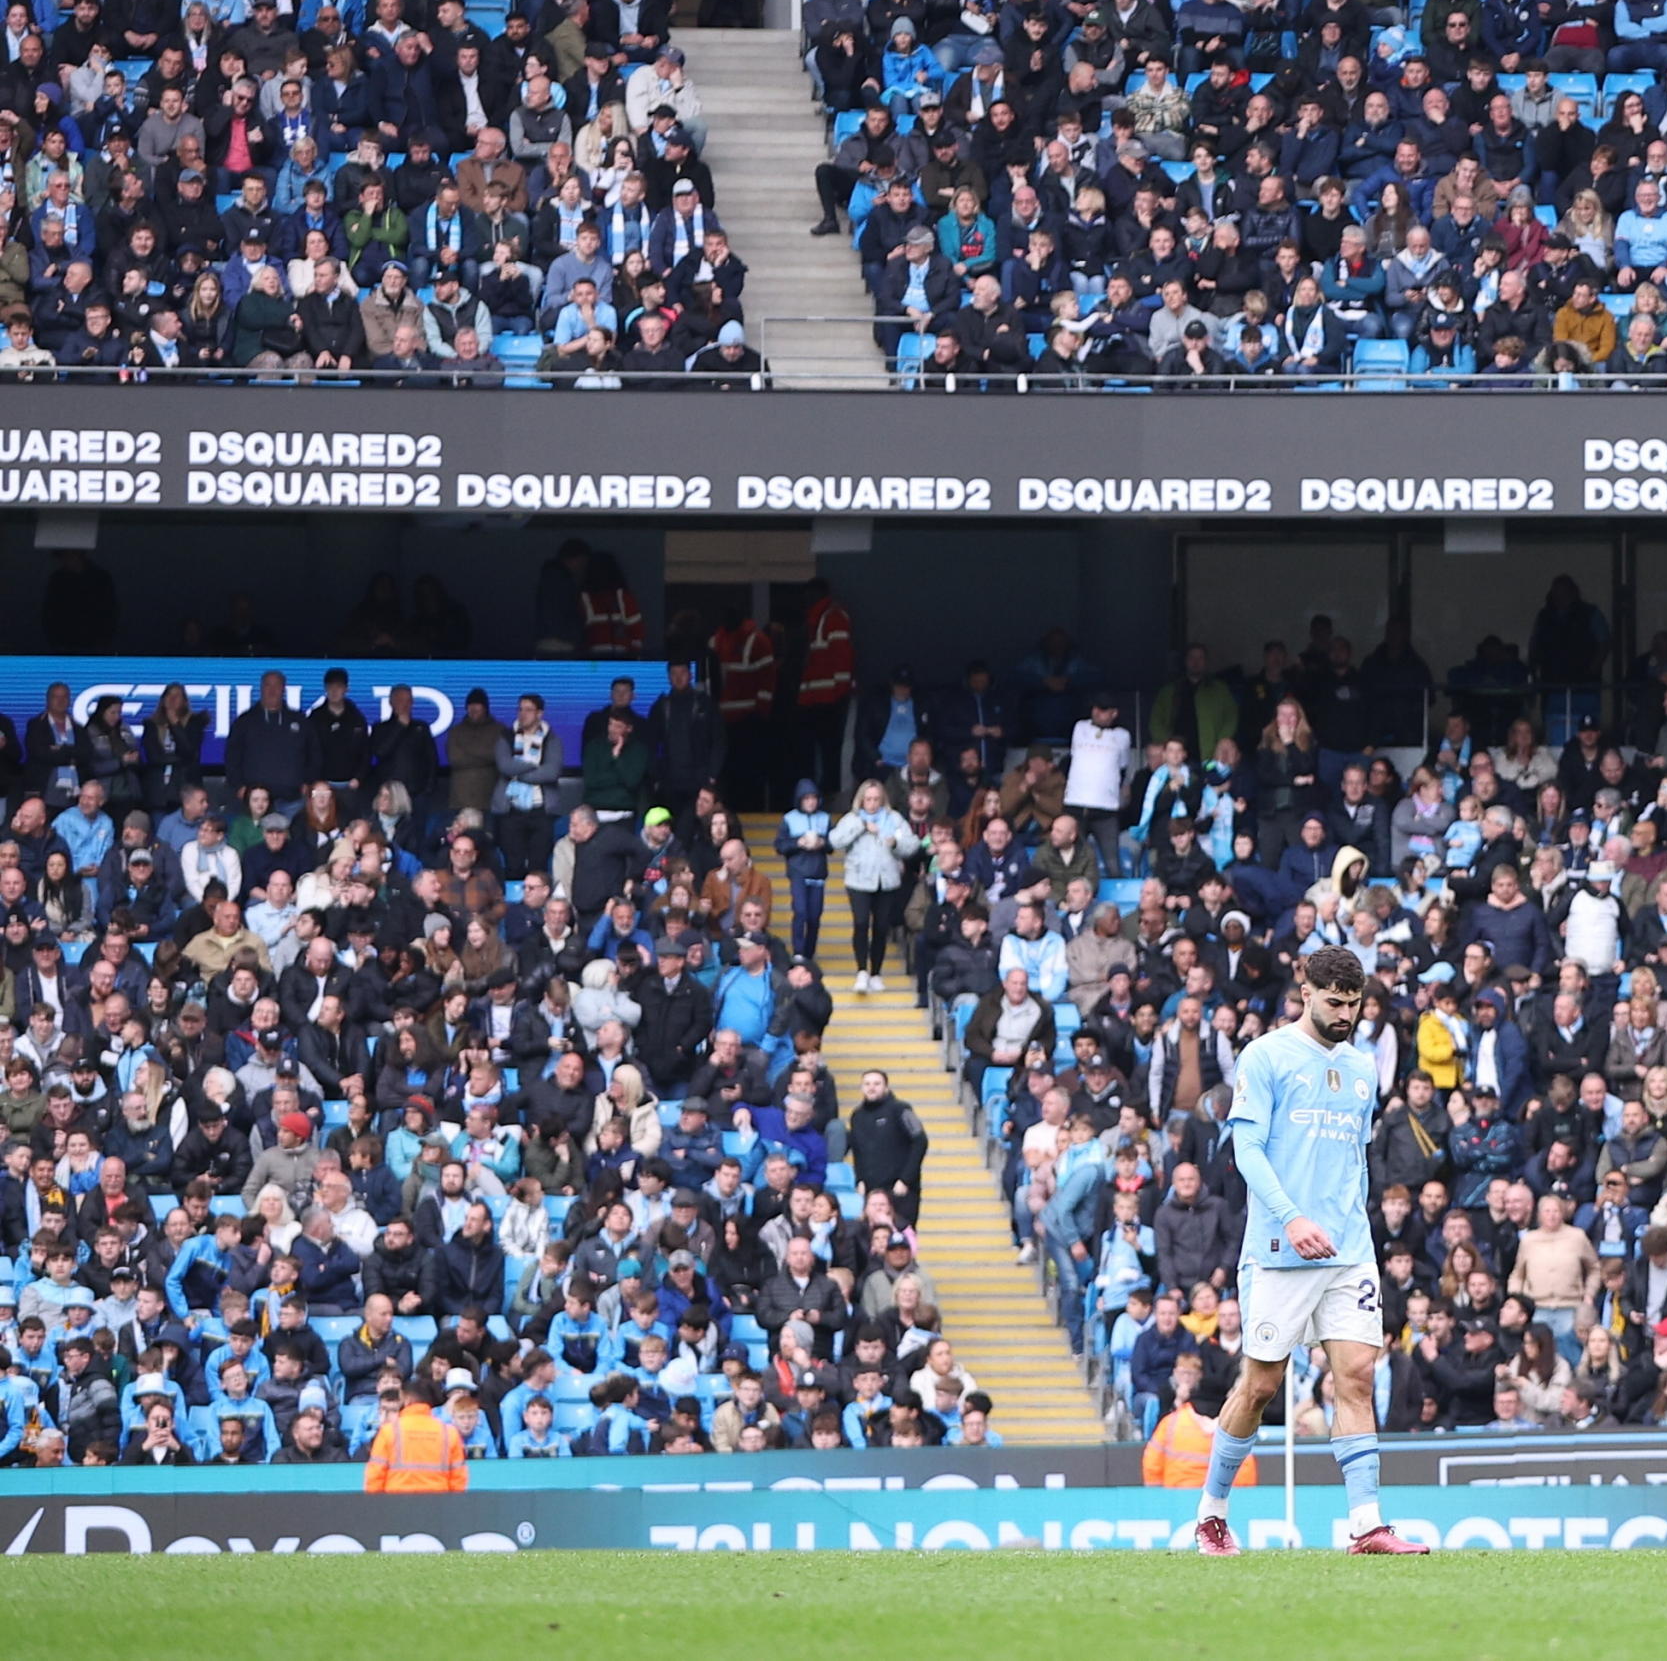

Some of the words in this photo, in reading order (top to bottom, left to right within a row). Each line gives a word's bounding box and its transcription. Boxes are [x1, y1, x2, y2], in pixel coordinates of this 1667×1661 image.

[190, 432, 441, 466] DSQUARED2
[188, 472, 440, 506] DSQUARED2
[458, 475, 710, 509] DSQUARED2
[738, 477, 990, 511] DSQUARED2
[1019, 479, 1270, 512] DSQUARED2
[1302, 479, 1553, 513] DSQUARED2
